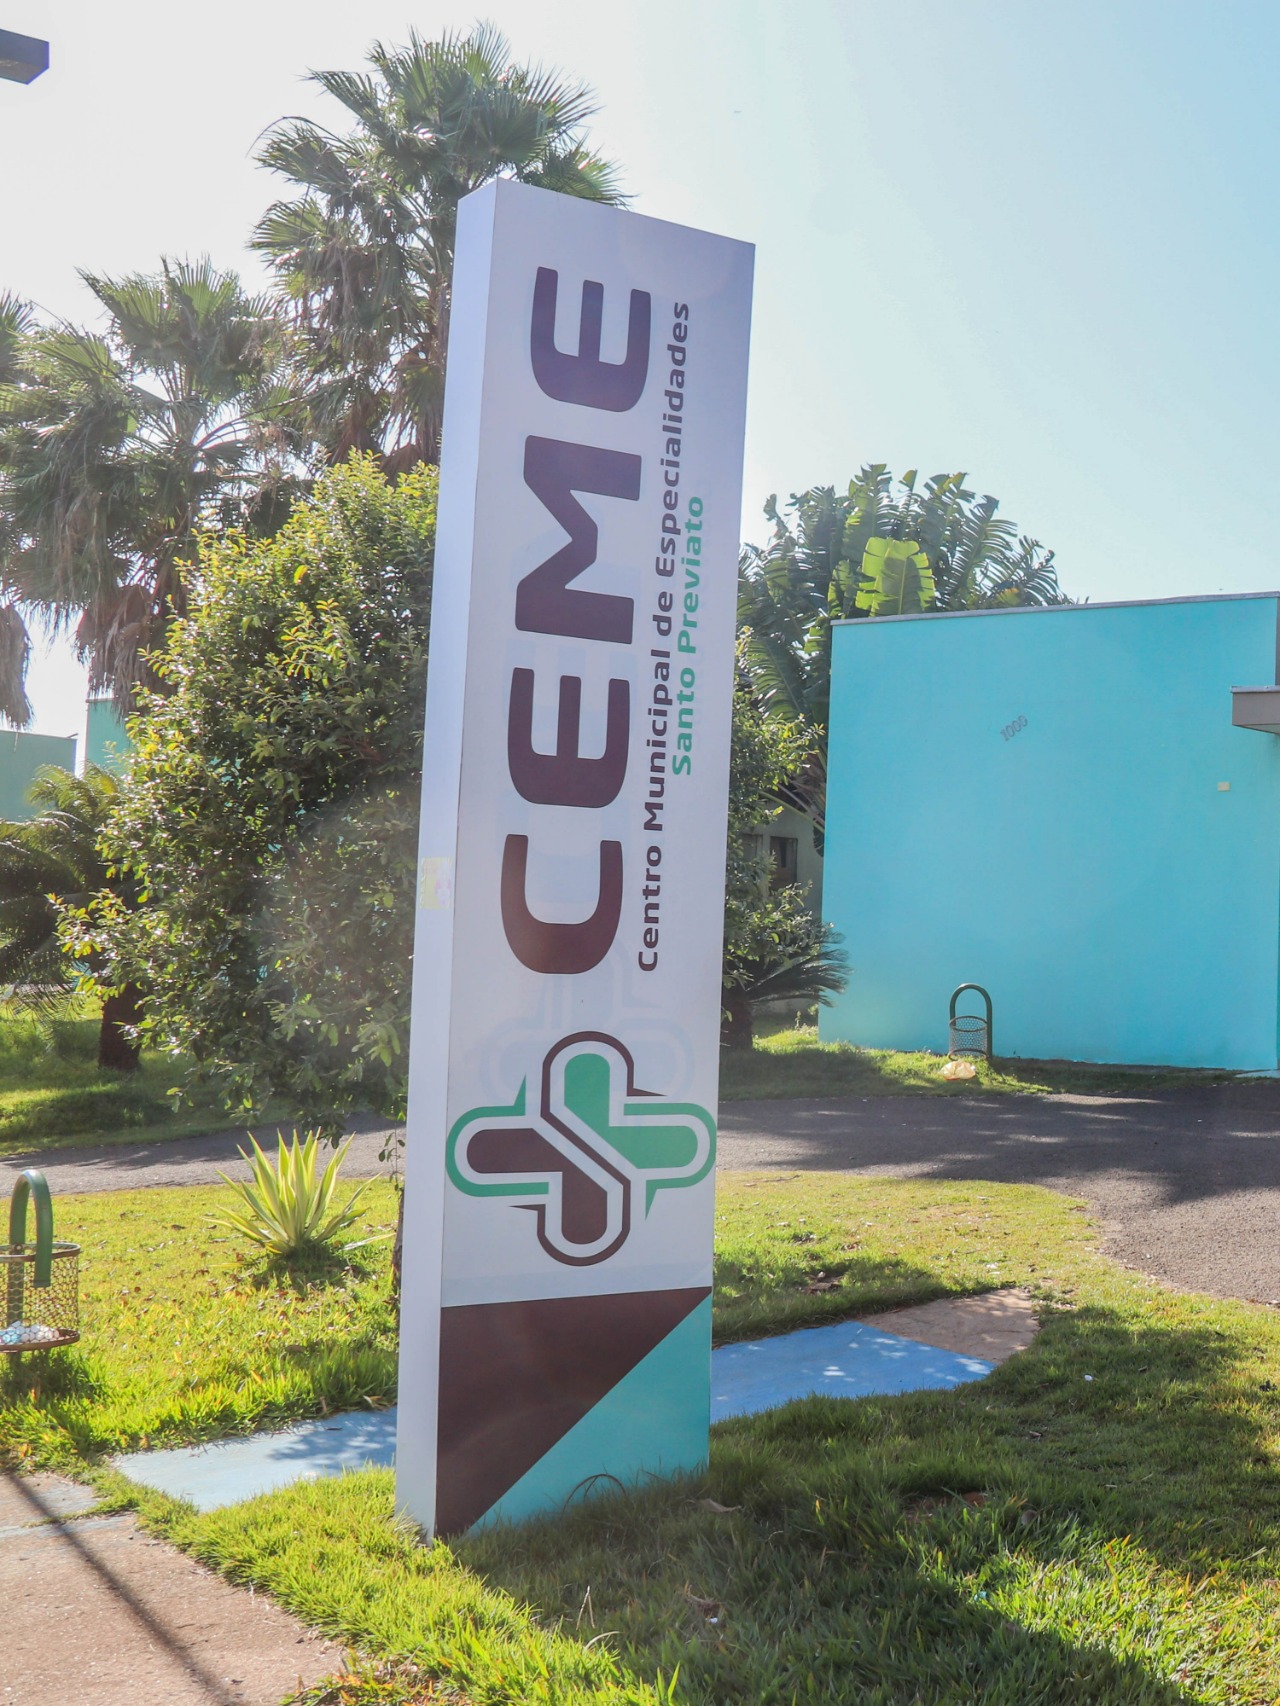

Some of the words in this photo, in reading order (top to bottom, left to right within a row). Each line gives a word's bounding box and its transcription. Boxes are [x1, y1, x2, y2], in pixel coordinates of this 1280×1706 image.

[655, 302, 689, 577] Especialidades
[500, 266, 651, 975] CEME
[652, 591, 673, 637] de
[677, 496, 704, 654] Previato
[643, 649, 673, 832] Municipal
[672, 667, 696, 776] Santo
[638, 845, 662, 972] Centro
